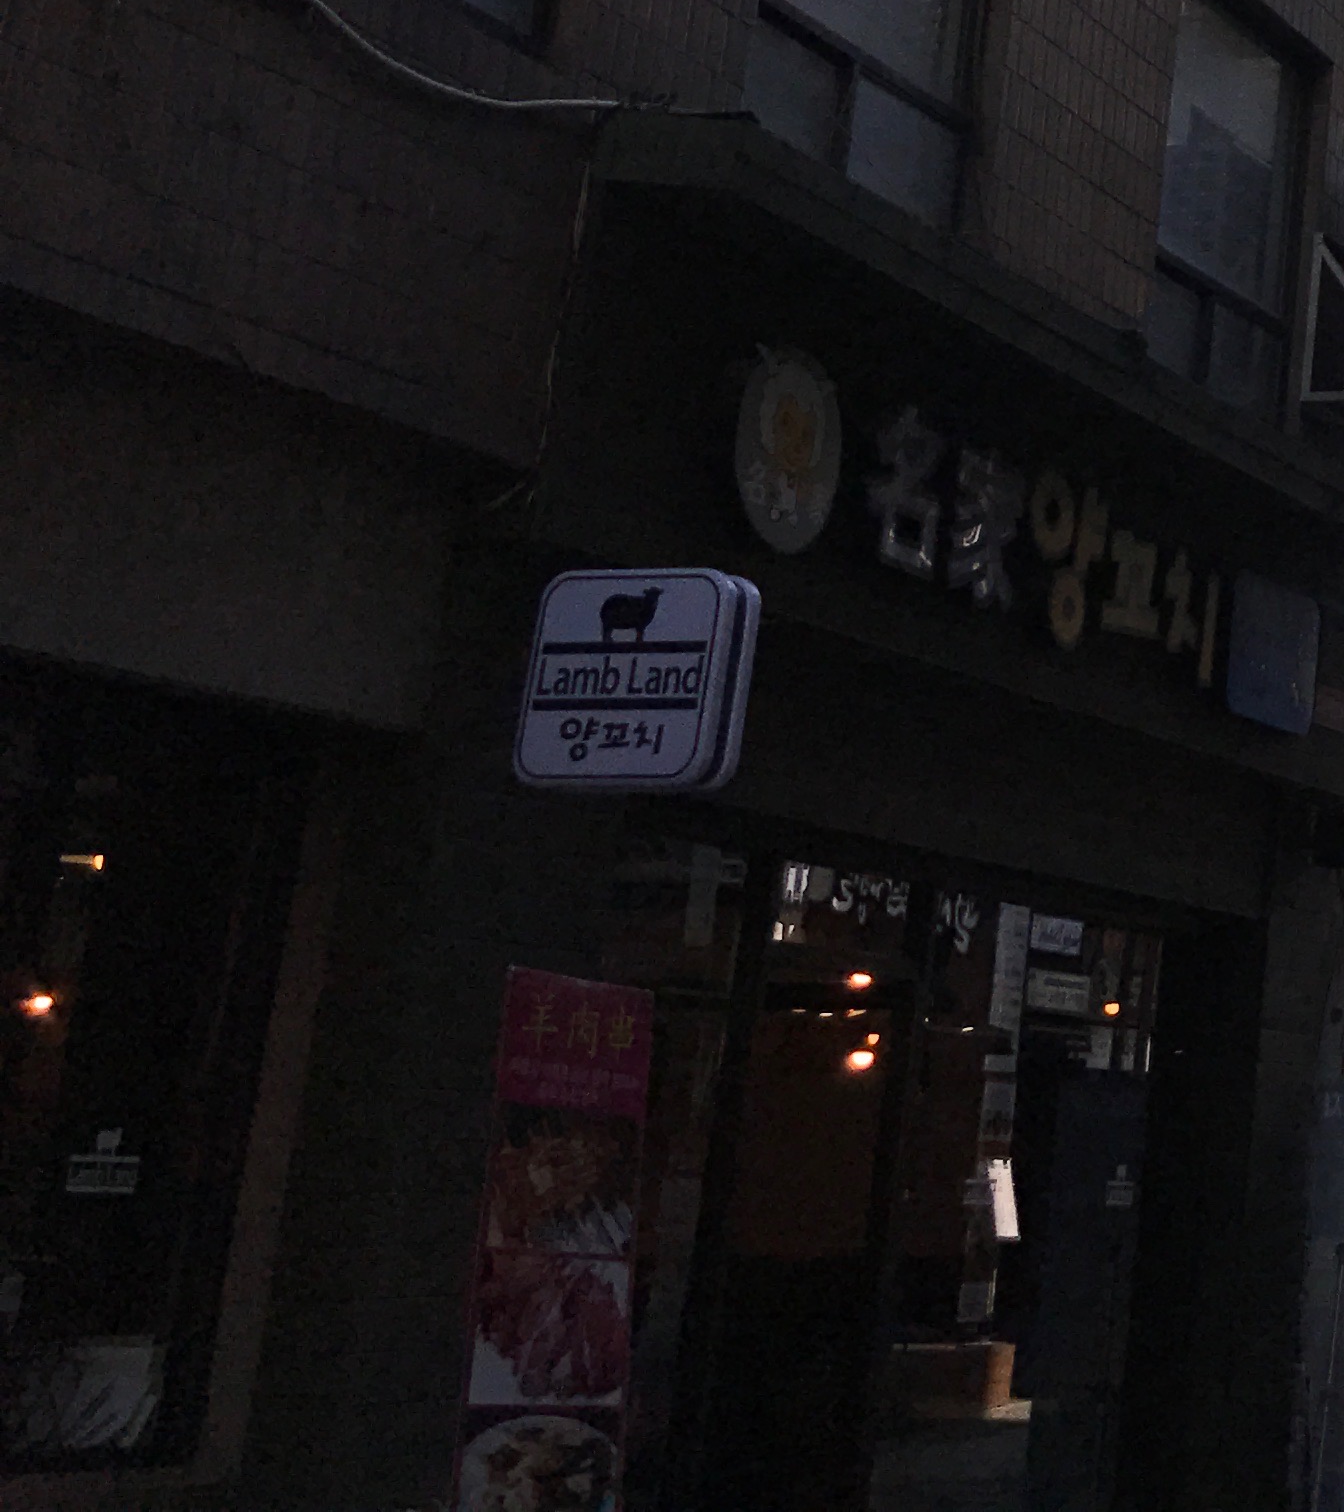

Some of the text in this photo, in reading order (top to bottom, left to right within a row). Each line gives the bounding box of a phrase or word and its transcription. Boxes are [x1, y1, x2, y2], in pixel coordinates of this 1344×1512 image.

[536, 653, 704, 695] Lamb Land
[559, 717, 665, 762] 양꼬치
